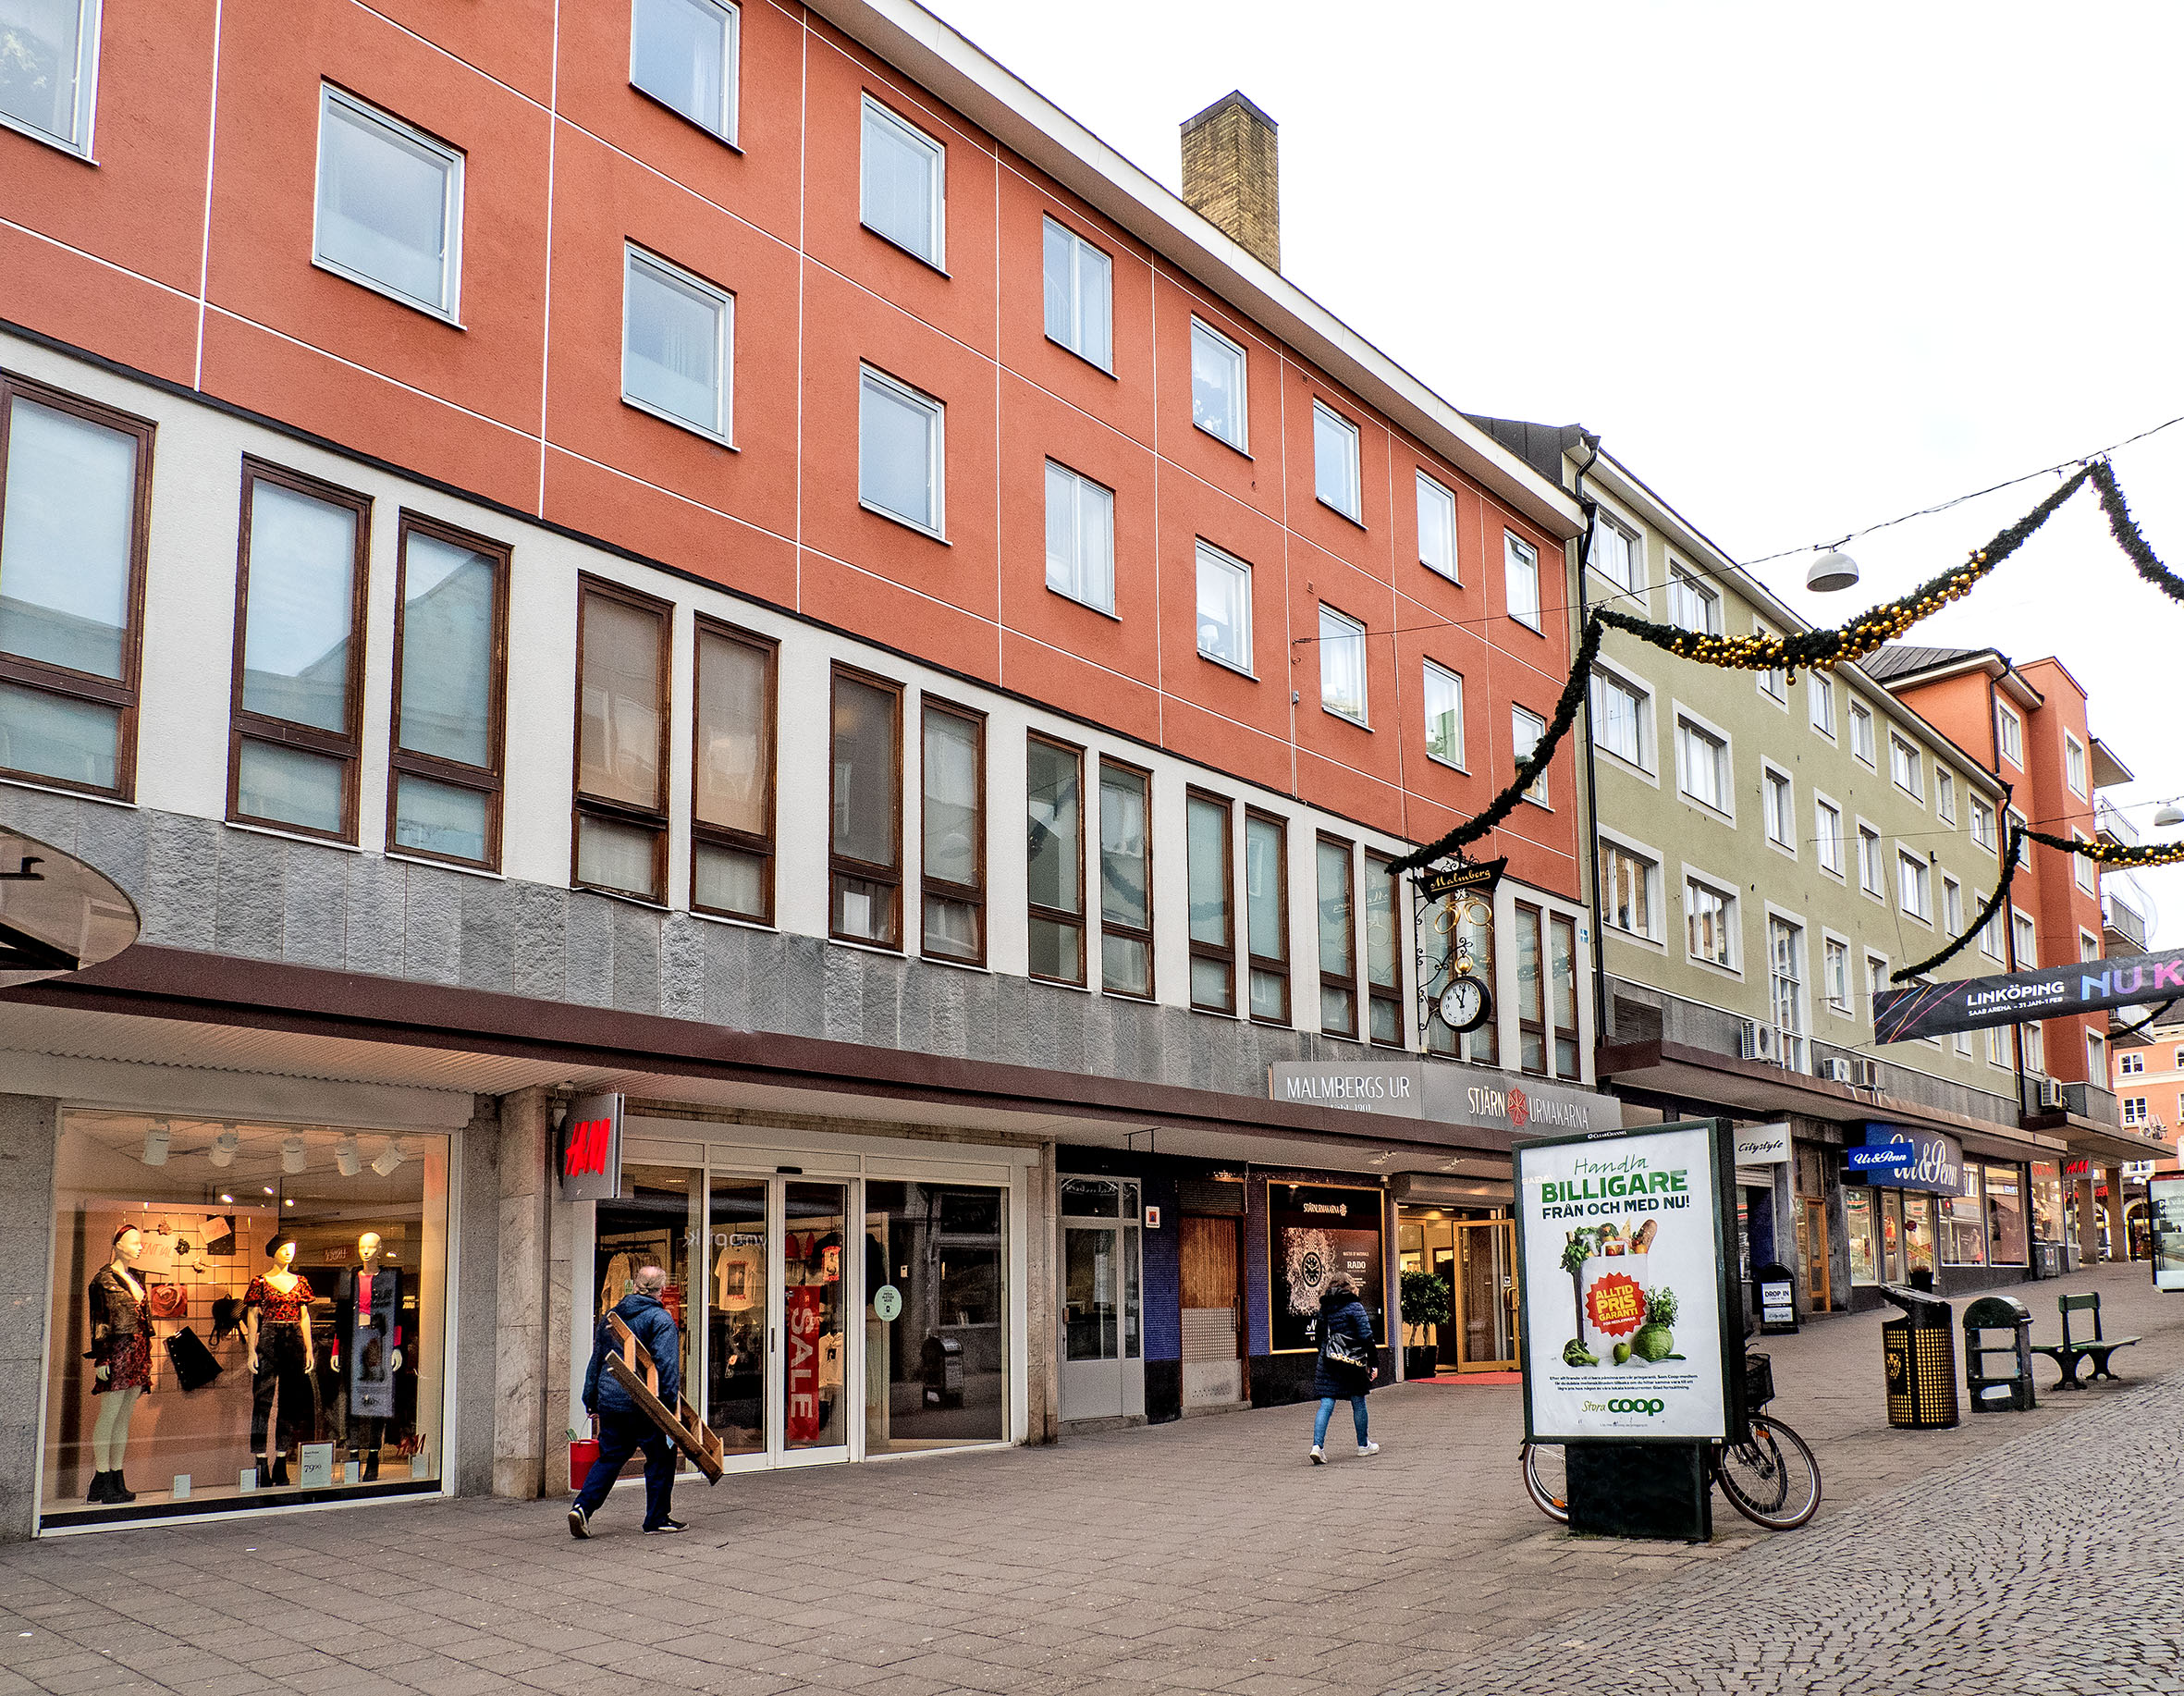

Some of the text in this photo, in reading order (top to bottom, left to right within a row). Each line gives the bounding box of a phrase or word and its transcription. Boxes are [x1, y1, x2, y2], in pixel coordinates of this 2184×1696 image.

[1429, 869, 1491, 889] Malmberg
[1967, 980, 2065, 1007] LINKÖPING
[2081, 966, 2143, 1002] NU
[1987, 1004, 2011, 1014] ARENA
[2049, 996, 2063, 1004] FEB
[1286, 1076, 1410, 1099] MALMBERGS UR
[1467, 1086, 1589, 1130] STJÄRN URMAKARNA
[565, 1117, 611, 1177] H&M
[1738, 1139, 1784, 1153] Citystyle
[1574, 1153, 1649, 1176] Handla
[1854, 1150, 1908, 1163] Ur&Penn
[2066, 1160, 2089, 1174] H&M
[1541, 1169, 1688, 1204] BILLIGARE
[1542, 1195, 1690, 1220] FRÅN OCH MED NU!
[1347, 1260, 1366, 1270] RADO
[1596, 1284, 1634, 1300] ALLTID
[1596, 1294, 1637, 1314] PRIS
[1599, 1308, 1638, 1321] GARANTI
[791, 1308, 814, 1419] SALE
[1330, 1352, 1356, 1365] adidas
[1582, 1398, 1664, 1417] Stora coop
